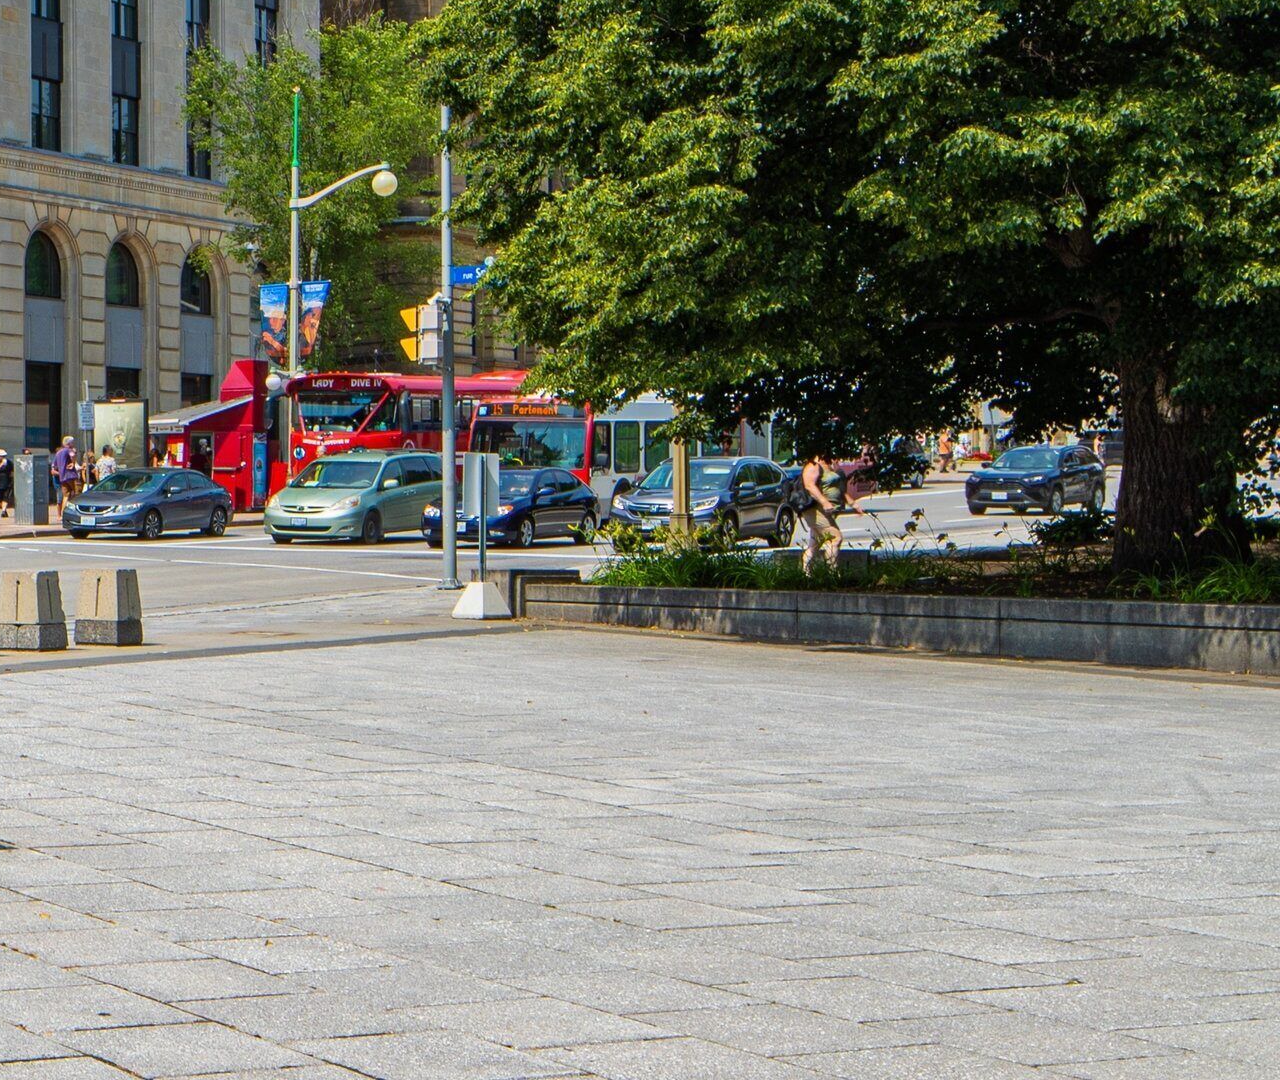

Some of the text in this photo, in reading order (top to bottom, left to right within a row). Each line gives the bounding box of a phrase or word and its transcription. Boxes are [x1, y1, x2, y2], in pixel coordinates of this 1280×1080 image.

[462, 272, 473, 280] rue
[312, 379, 382, 388] LADY DIVE IV
[492, 404, 503, 415] 15
